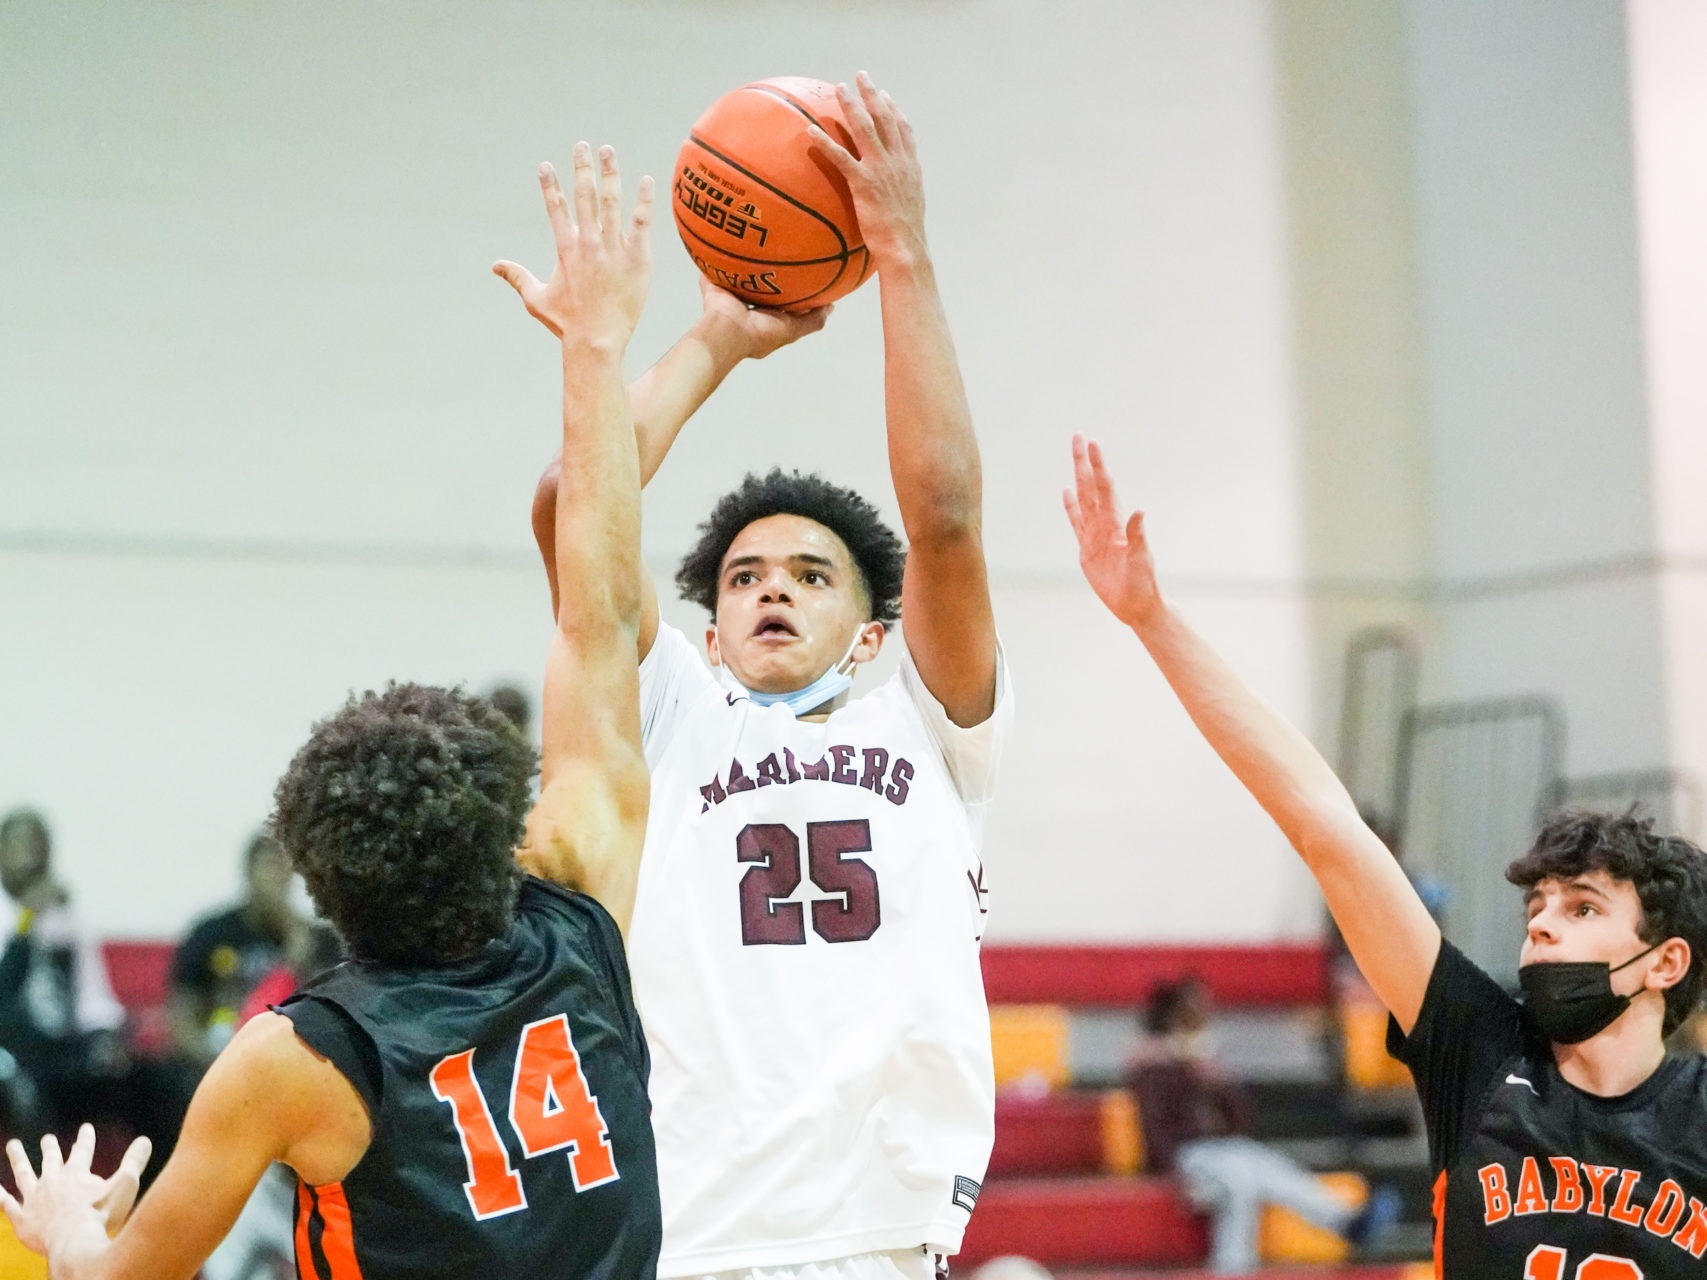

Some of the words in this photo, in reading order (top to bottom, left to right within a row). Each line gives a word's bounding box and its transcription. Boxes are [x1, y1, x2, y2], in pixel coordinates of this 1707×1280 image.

[674, 178, 769, 248] LEGACY
[683, 166, 735, 209] 1000
[736, 818, 882, 946] 25
[429, 1012, 621, 1221] 14
[1478, 1156, 1707, 1259] BABYLON
